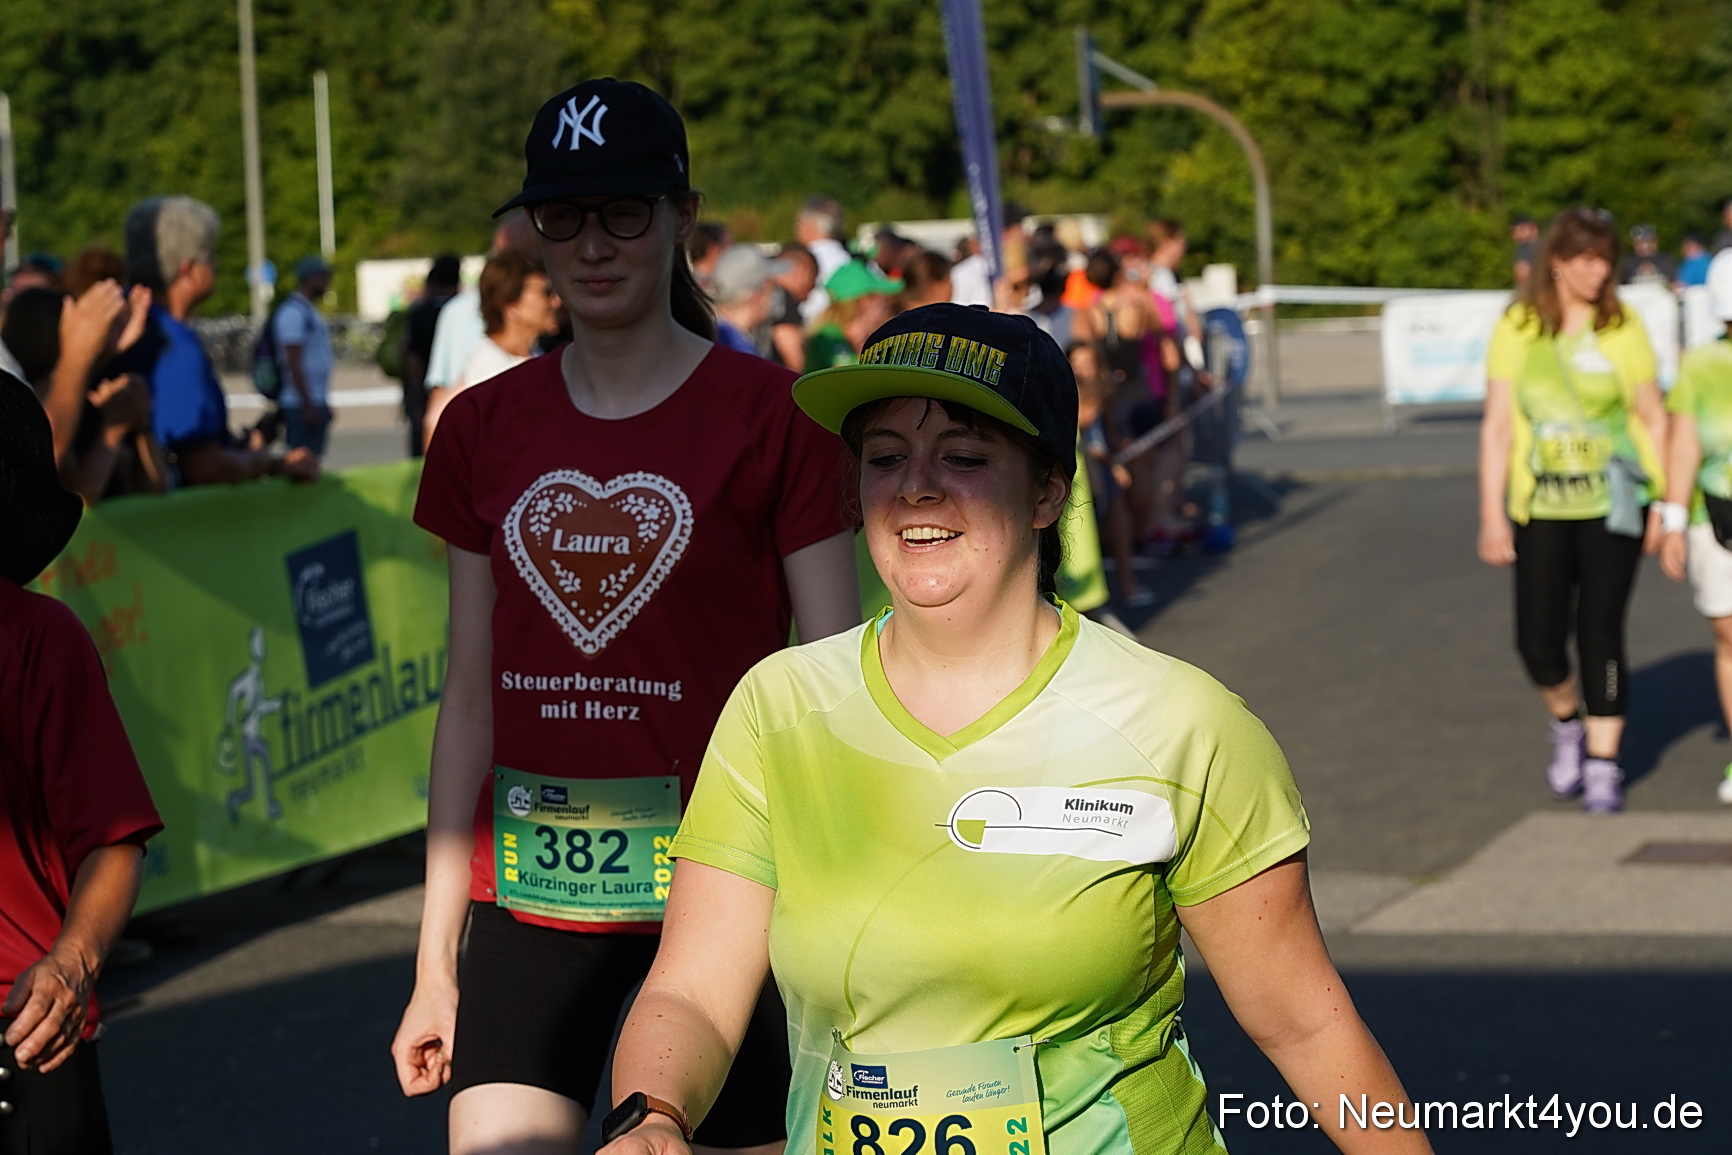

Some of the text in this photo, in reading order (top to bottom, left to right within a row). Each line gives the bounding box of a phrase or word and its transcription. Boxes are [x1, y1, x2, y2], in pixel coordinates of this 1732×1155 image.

[551, 94, 609, 151] NY
[944, 335, 1008, 386] ONE
[551, 528, 631, 555] Laura
[501, 671, 683, 701] Steuerberatung
[279, 638, 448, 772] firmenlau
[541, 699, 640, 721] mit Herz
[534, 803, 590, 815] Firmenlauf
[1062, 813, 1129, 829] Neumarkt
[1064, 798, 1134, 816] Klinikum
[503, 833, 519, 882] RUN
[535, 825, 630, 875] 382
[653, 835, 671, 900] 2022
[518, 869, 597, 897] Kürzinger
[602, 880, 653, 895] Laura
[856, 1071, 885, 1081] Fischer
[946, 1079, 1002, 1099] Gesunde Firmen
[846, 1085, 918, 1100] Firmenlauf
[872, 1099, 918, 1109] neumarkt
[962, 1084, 1011, 1104] laufen länger!
[821, 1105, 835, 1155] LK
[850, 1114, 977, 1155] 826
[1006, 1116, 1029, 1155] 22
